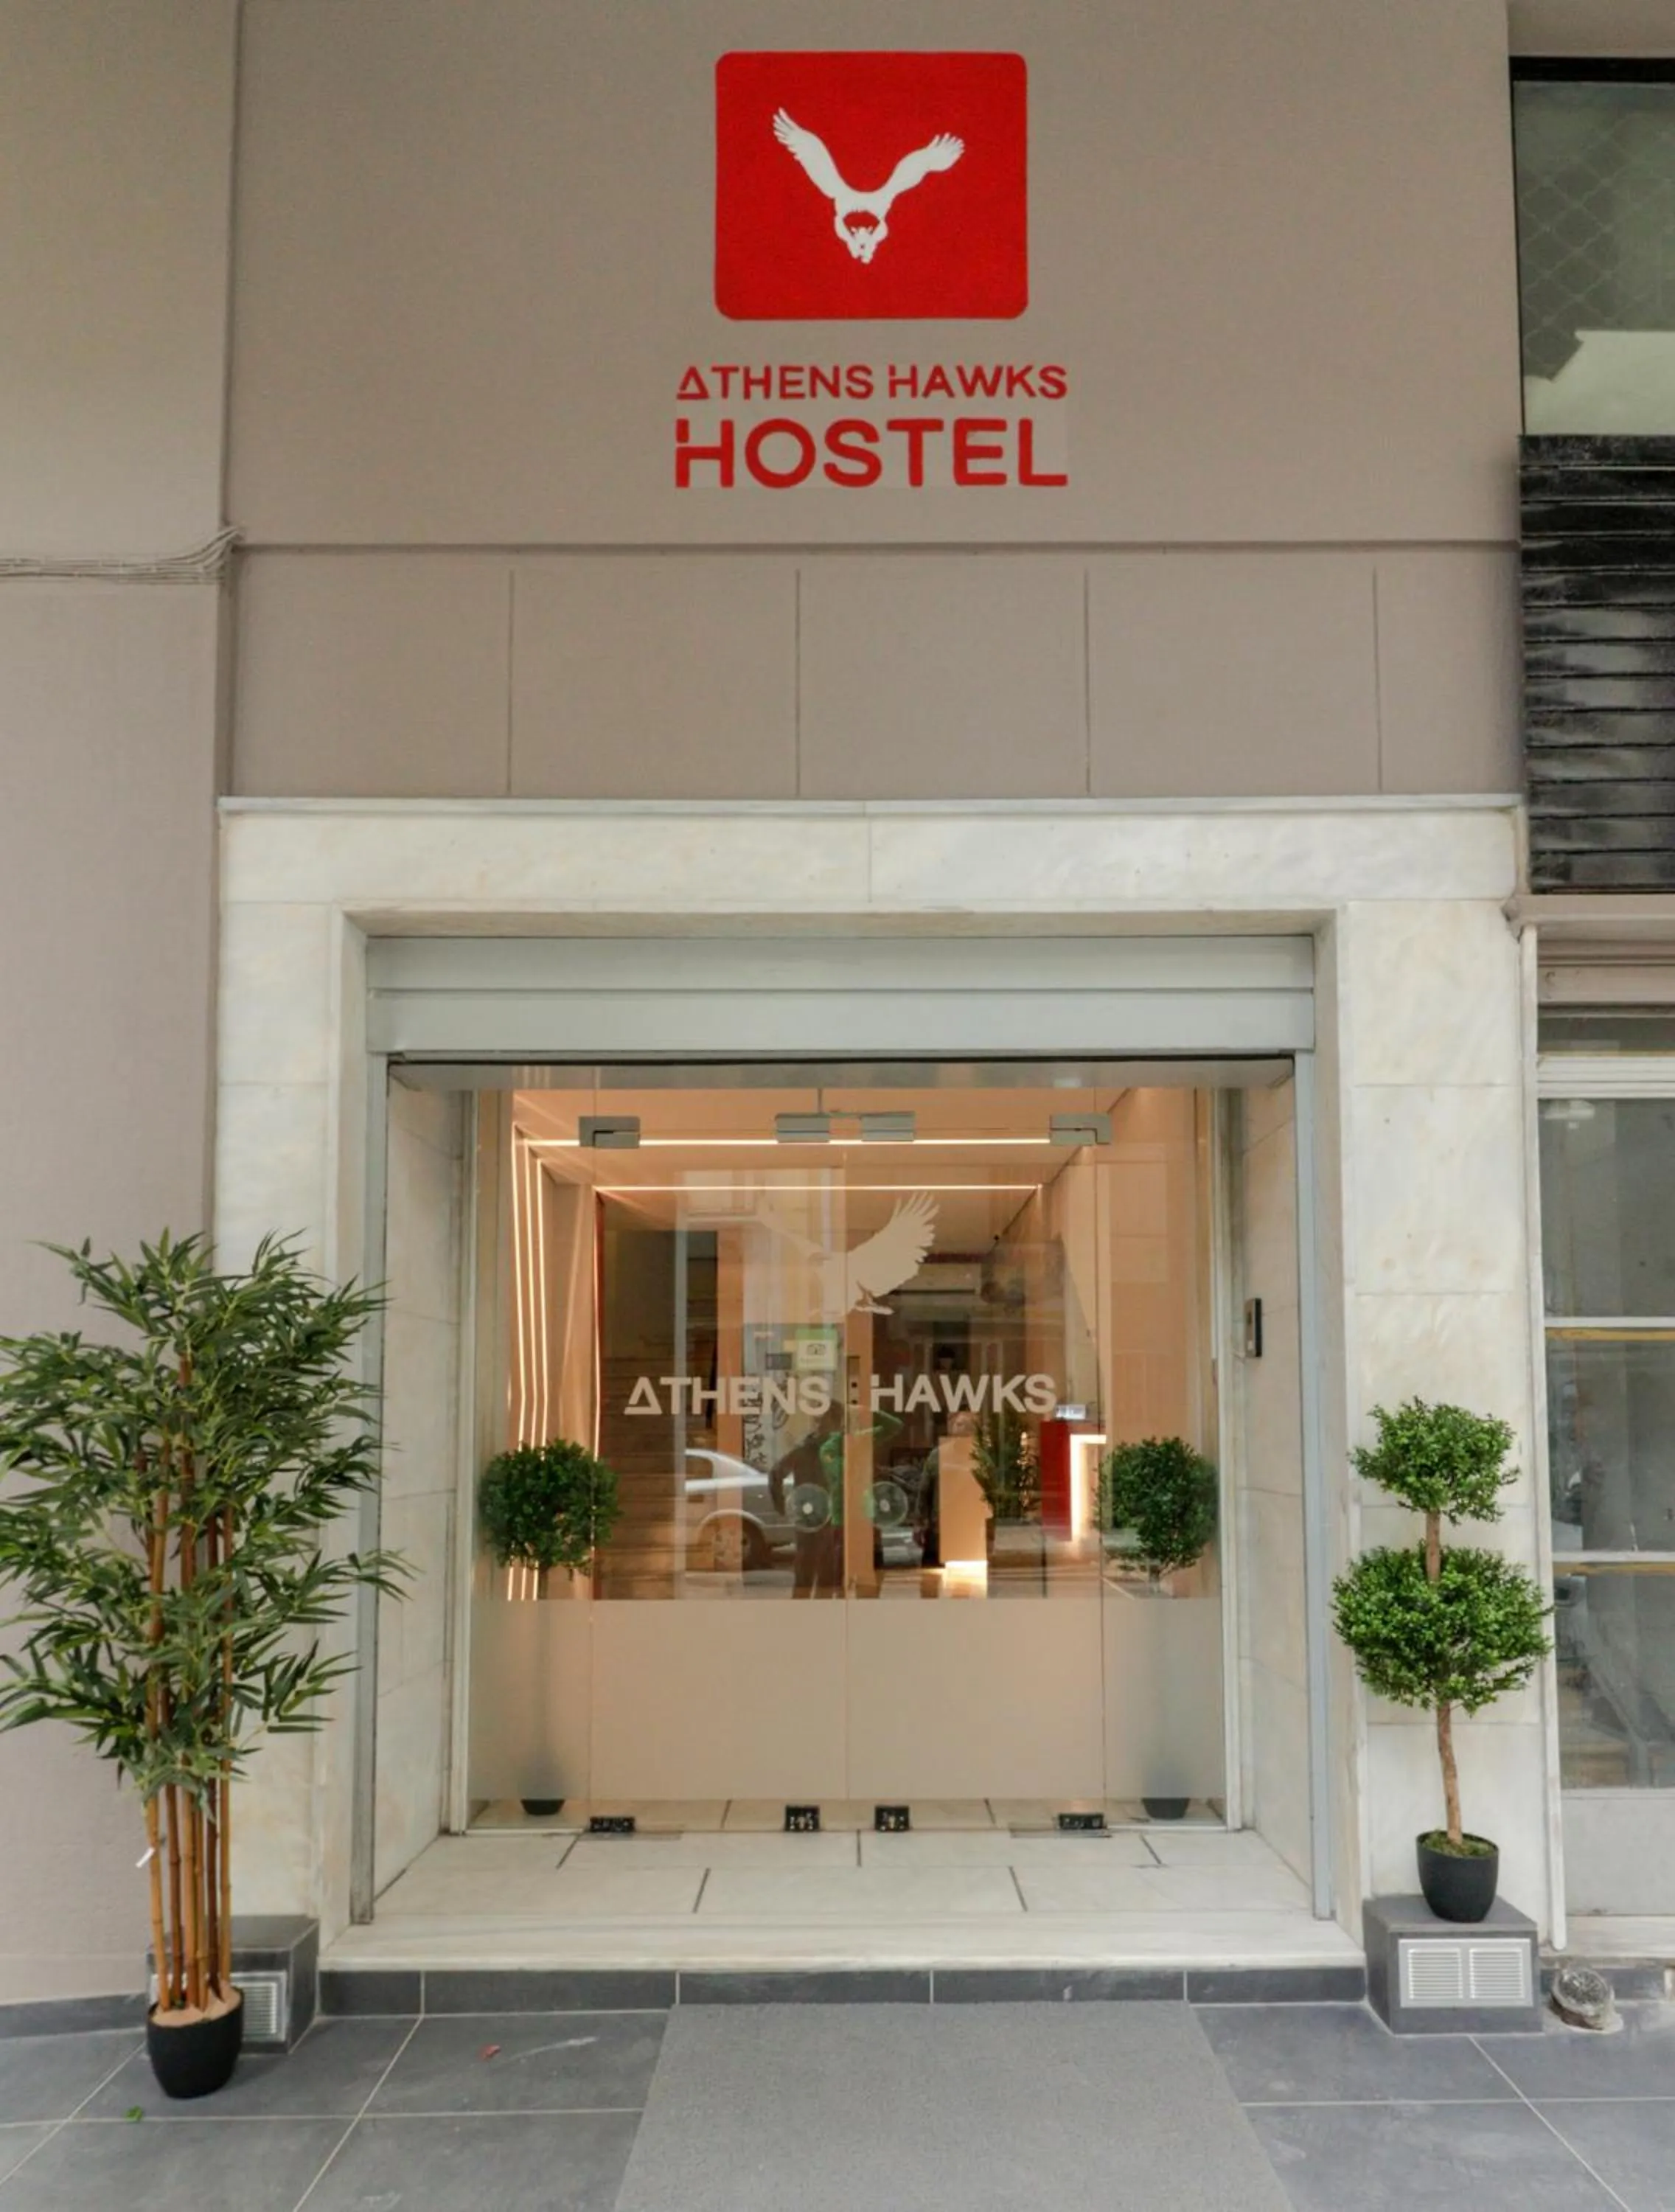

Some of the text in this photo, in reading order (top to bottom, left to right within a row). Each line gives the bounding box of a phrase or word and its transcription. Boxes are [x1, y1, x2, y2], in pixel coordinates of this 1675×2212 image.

[676, 364, 1068, 400] ATHENS HAWKS
[675, 418, 1068, 488] HOSTEL
[624, 1373, 1056, 1416] ATHENS HAWKS
